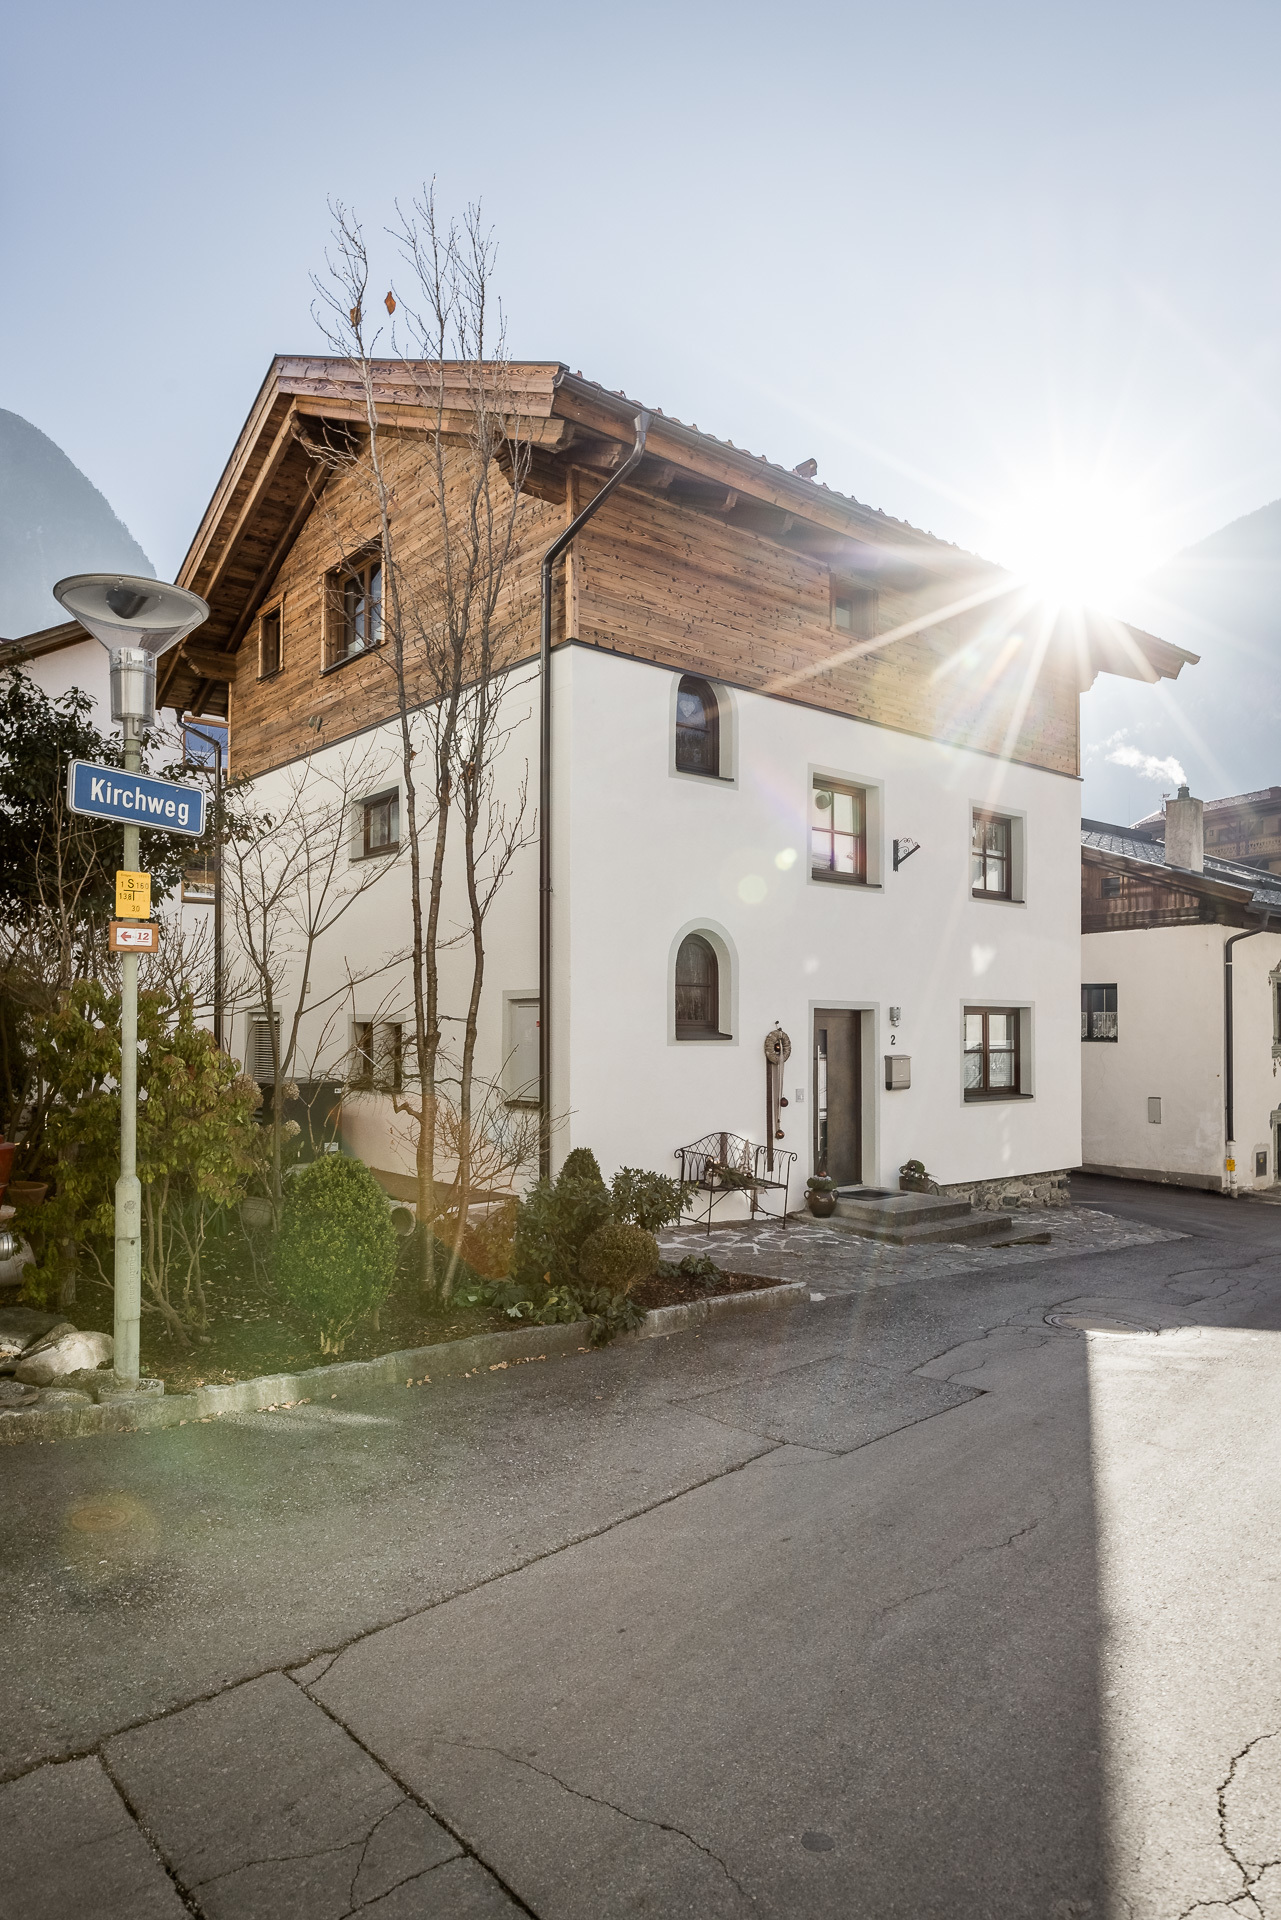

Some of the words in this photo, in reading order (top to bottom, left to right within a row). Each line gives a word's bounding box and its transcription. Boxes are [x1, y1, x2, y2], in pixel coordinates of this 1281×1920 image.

[90, 776, 189, 826] Kirchweg
[127, 878, 135, 889] S
[136, 931, 150, 942] 12
[890, 1034, 896, 1046] 2
